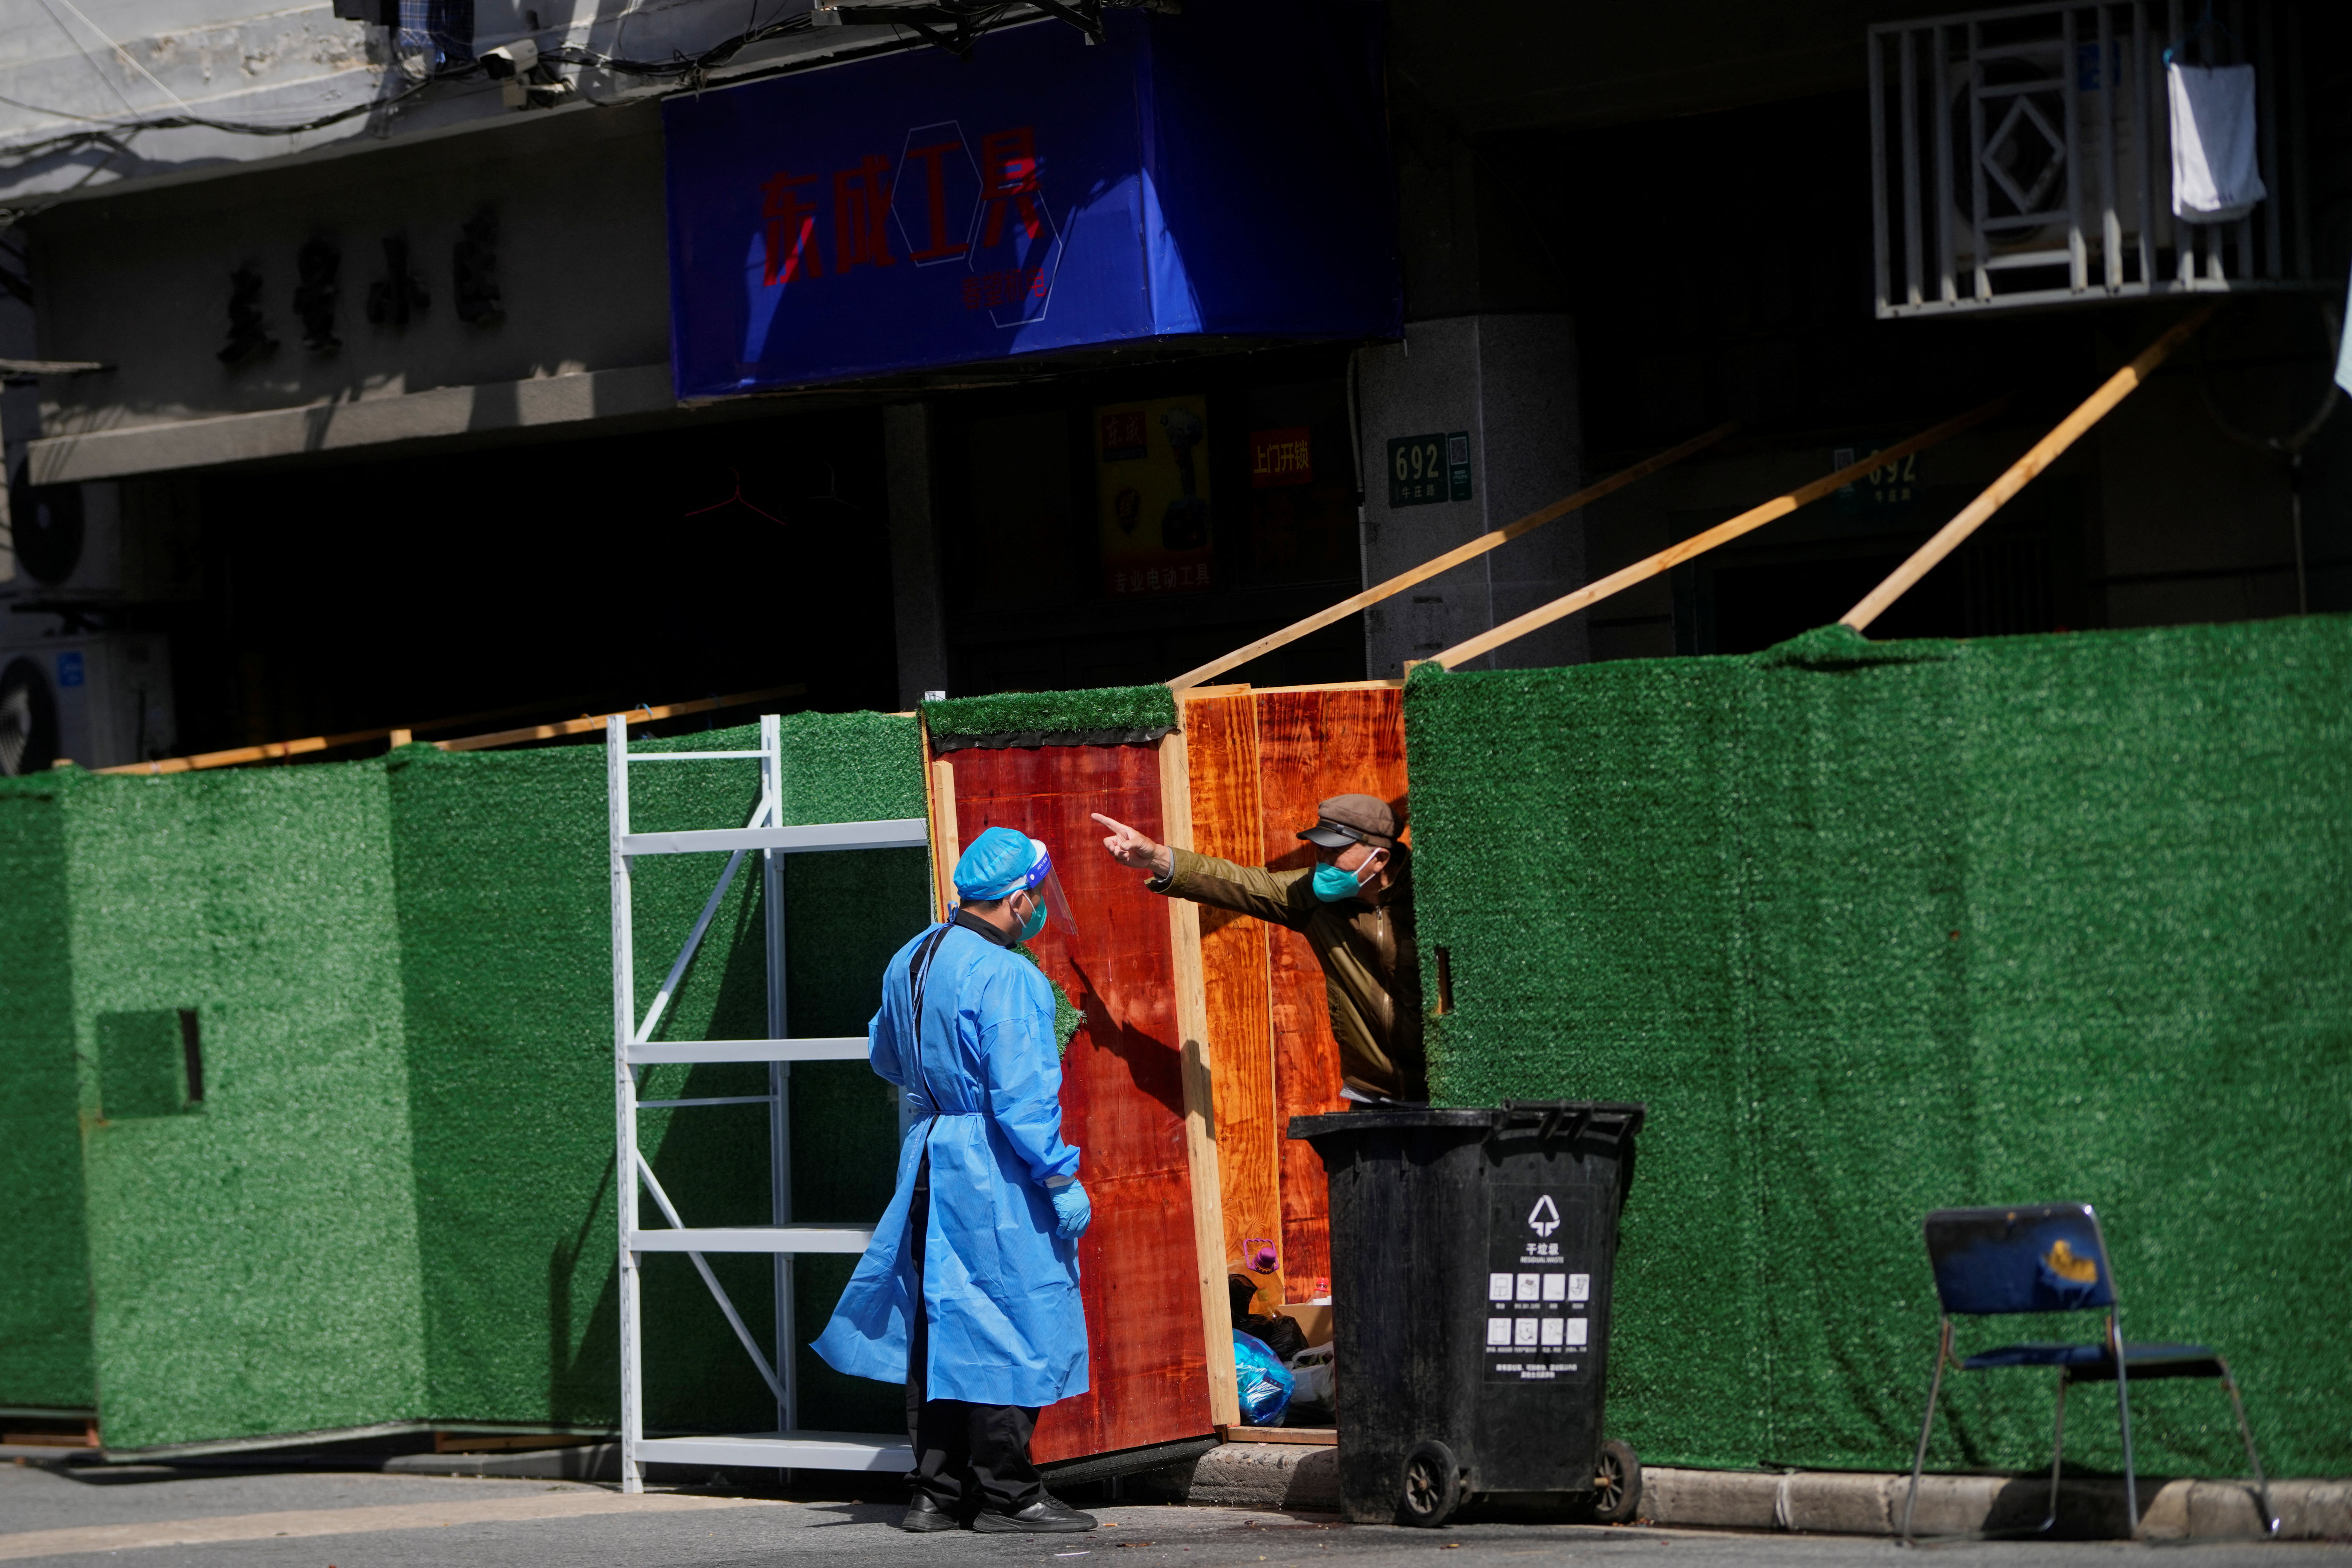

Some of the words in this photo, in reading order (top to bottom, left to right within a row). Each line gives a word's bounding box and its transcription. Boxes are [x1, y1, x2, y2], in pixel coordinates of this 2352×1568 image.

[761, 125, 1046, 287] 东成工具
[962, 264, 1047, 311] 春望机电
[1105, 415, 1143, 447] 东成
[1253, 439, 1309, 474] 上门开锁
[1396, 443, 1439, 481] 692
[1401, 484, 1435, 499] 牛庄路
[1113, 562, 1211, 594] 专业电动工具
[1525, 1242, 1559, 1256] 干垃圾
